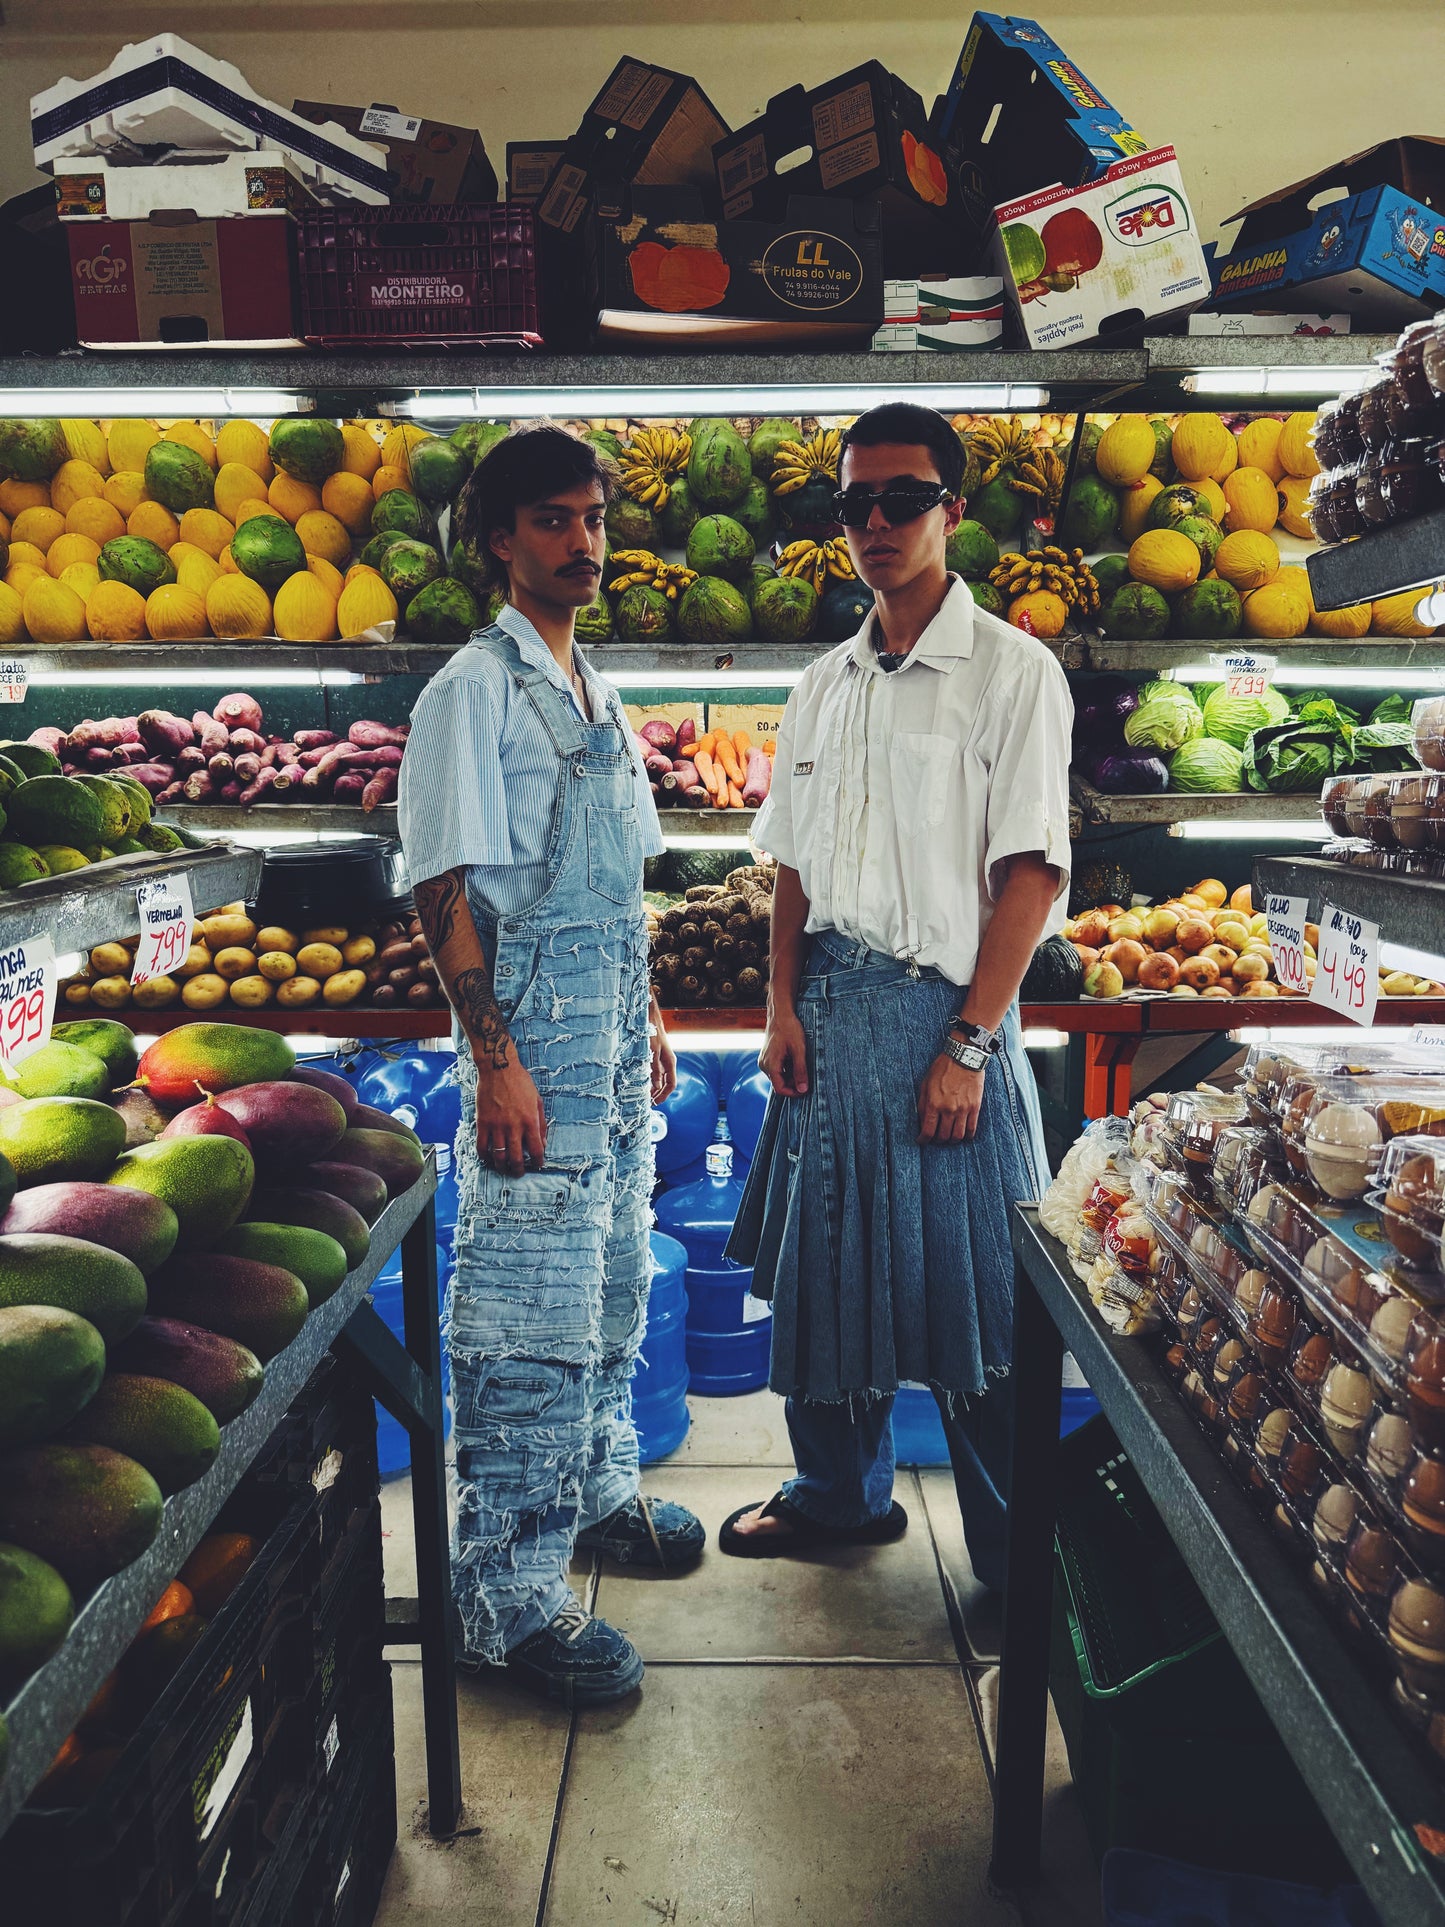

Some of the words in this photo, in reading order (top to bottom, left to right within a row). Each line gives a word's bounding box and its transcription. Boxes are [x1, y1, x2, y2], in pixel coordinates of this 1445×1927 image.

[1046, 60, 1096, 108] GALINHA
[1059, 61, 1111, 110] pintadinha
[1118, 201, 1176, 238] Dole
[796, 240, 830, 266] LL
[1220, 248, 1288, 283] GALINHA
[76, 255, 127, 283] AGP
[387, 276, 447, 285] DISTRIBUIDORA
[773, 265, 808, 279] Frutas
[810, 267, 825, 279] do
[827, 268, 852, 280] Vale
[1213, 265, 1285, 300] pintadinha
[371, 284, 464, 299] MONTEIRO
[785, 281, 794, 289] 74
[1037, 327, 1067, 344] Apples
[1225, 656, 1256, 667] MELÃO
[1229, 675, 1265, 696] 7,99
[1269, 897, 1290, 915] ALHO
[1330, 910, 1362, 941] ALHO
[150, 921, 187, 973] 7,99
[1322, 947, 1366, 1008] 4,49
